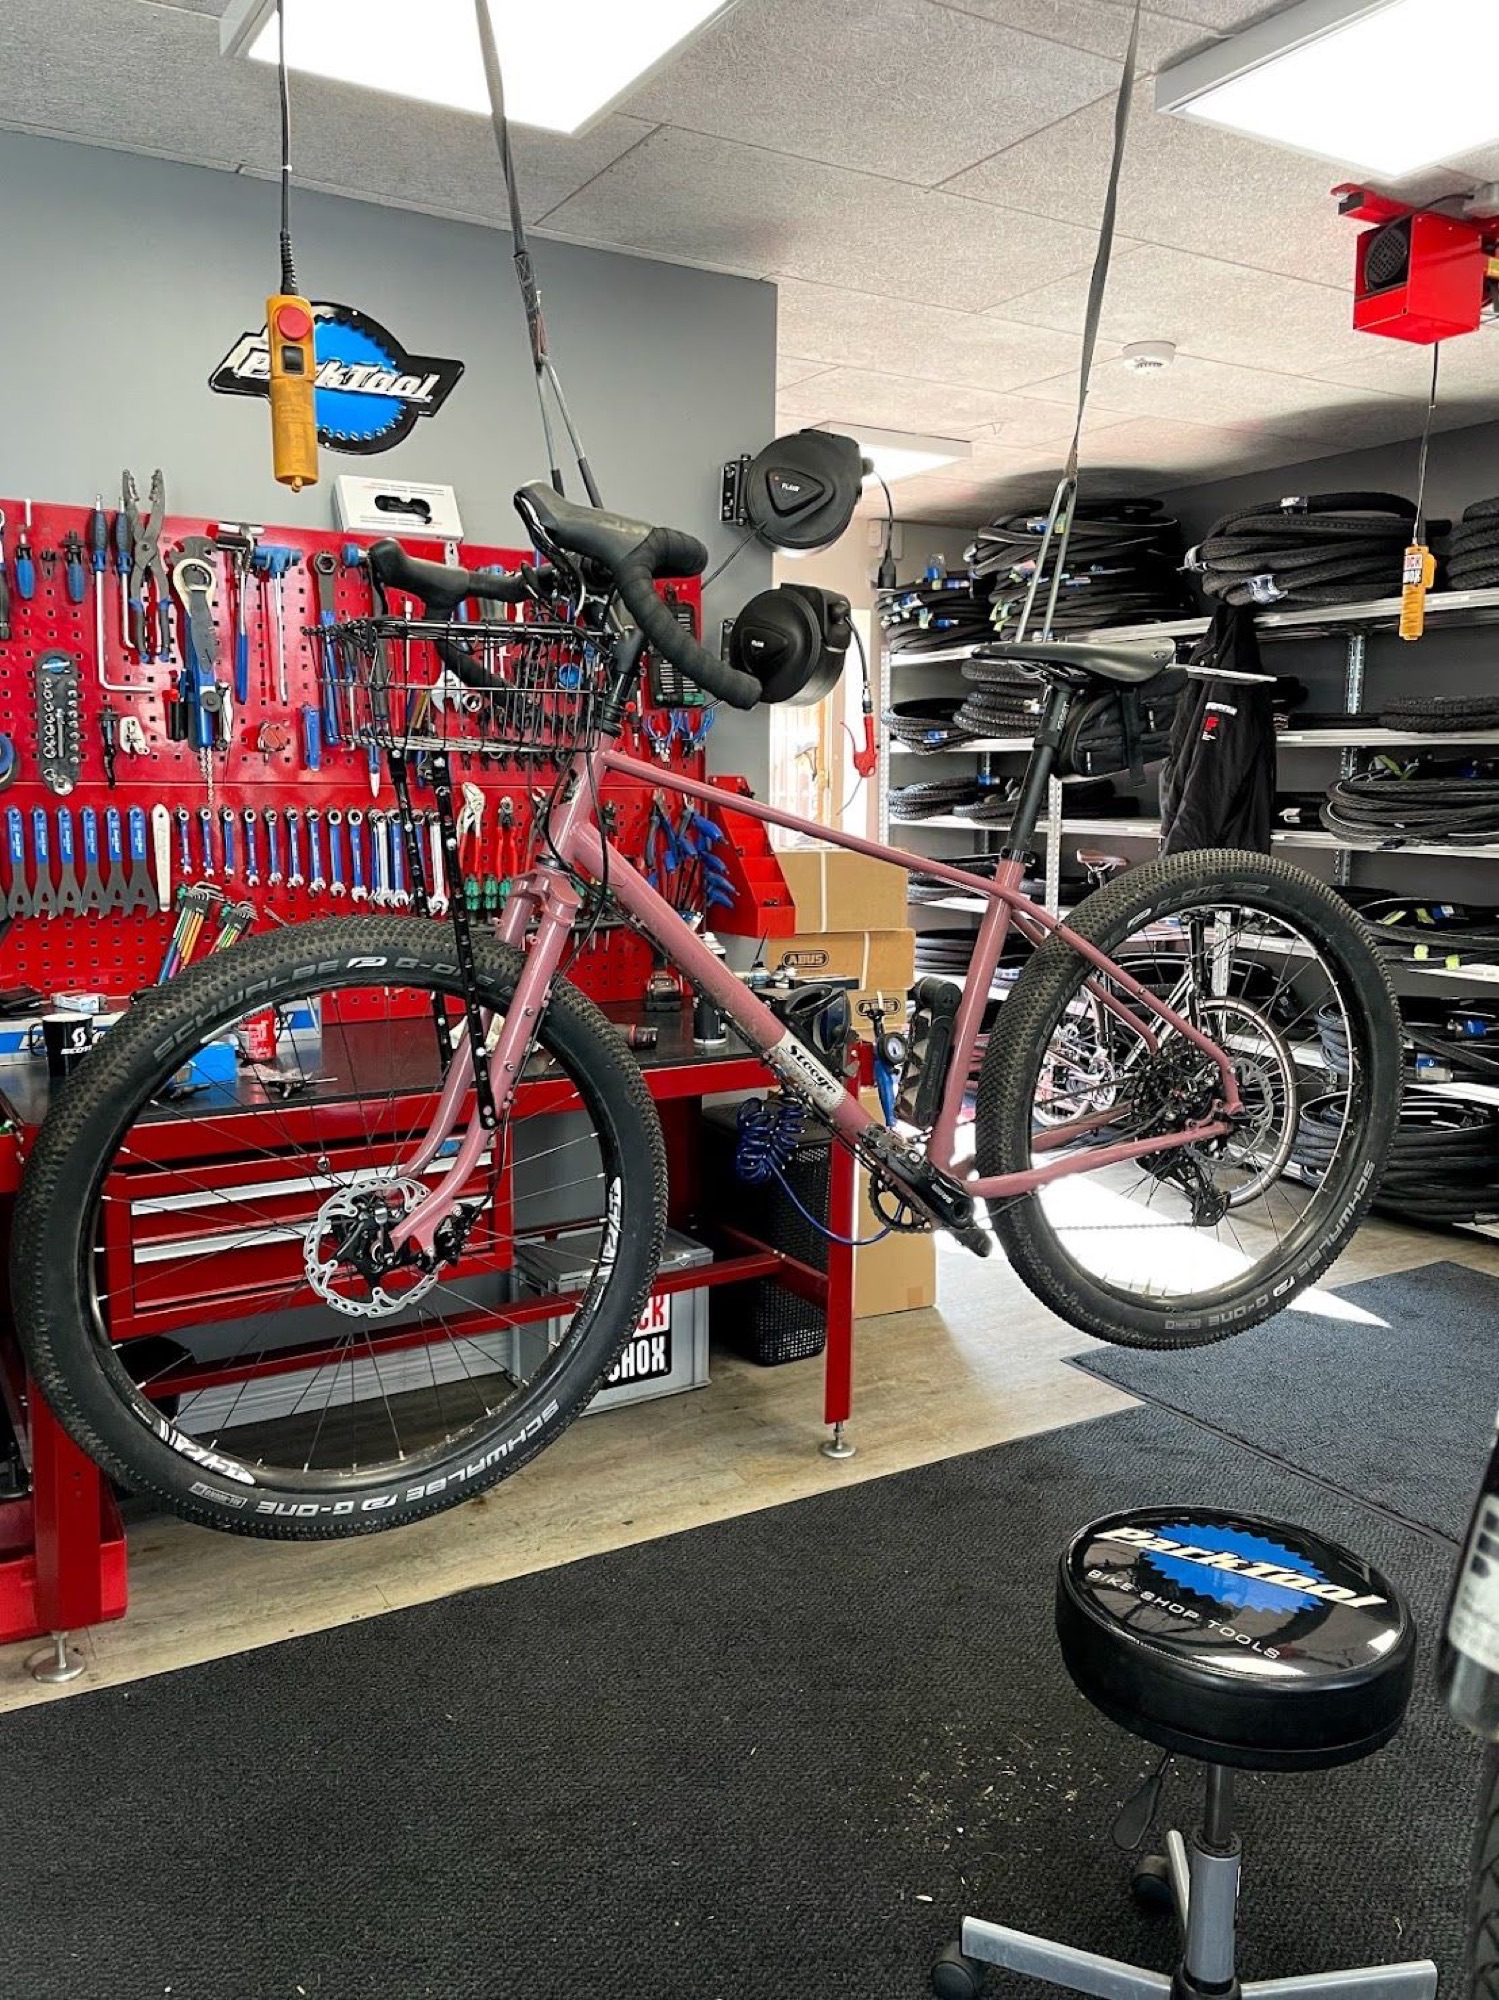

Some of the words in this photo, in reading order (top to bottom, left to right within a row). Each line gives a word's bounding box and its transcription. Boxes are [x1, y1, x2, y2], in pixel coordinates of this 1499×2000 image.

[786, 952, 824, 965] ABUS
[1297, 1159, 1376, 1276] SCHWALBE
[406, 1398, 560, 1503] SCHWALBE
[256, 1499, 354, 1517] G-ONE
[1087, 1569, 1132, 1592] BIKE
[1140, 1589, 1200, 1619] SHOP
[1207, 1619, 1280, 1660] TOOLS
